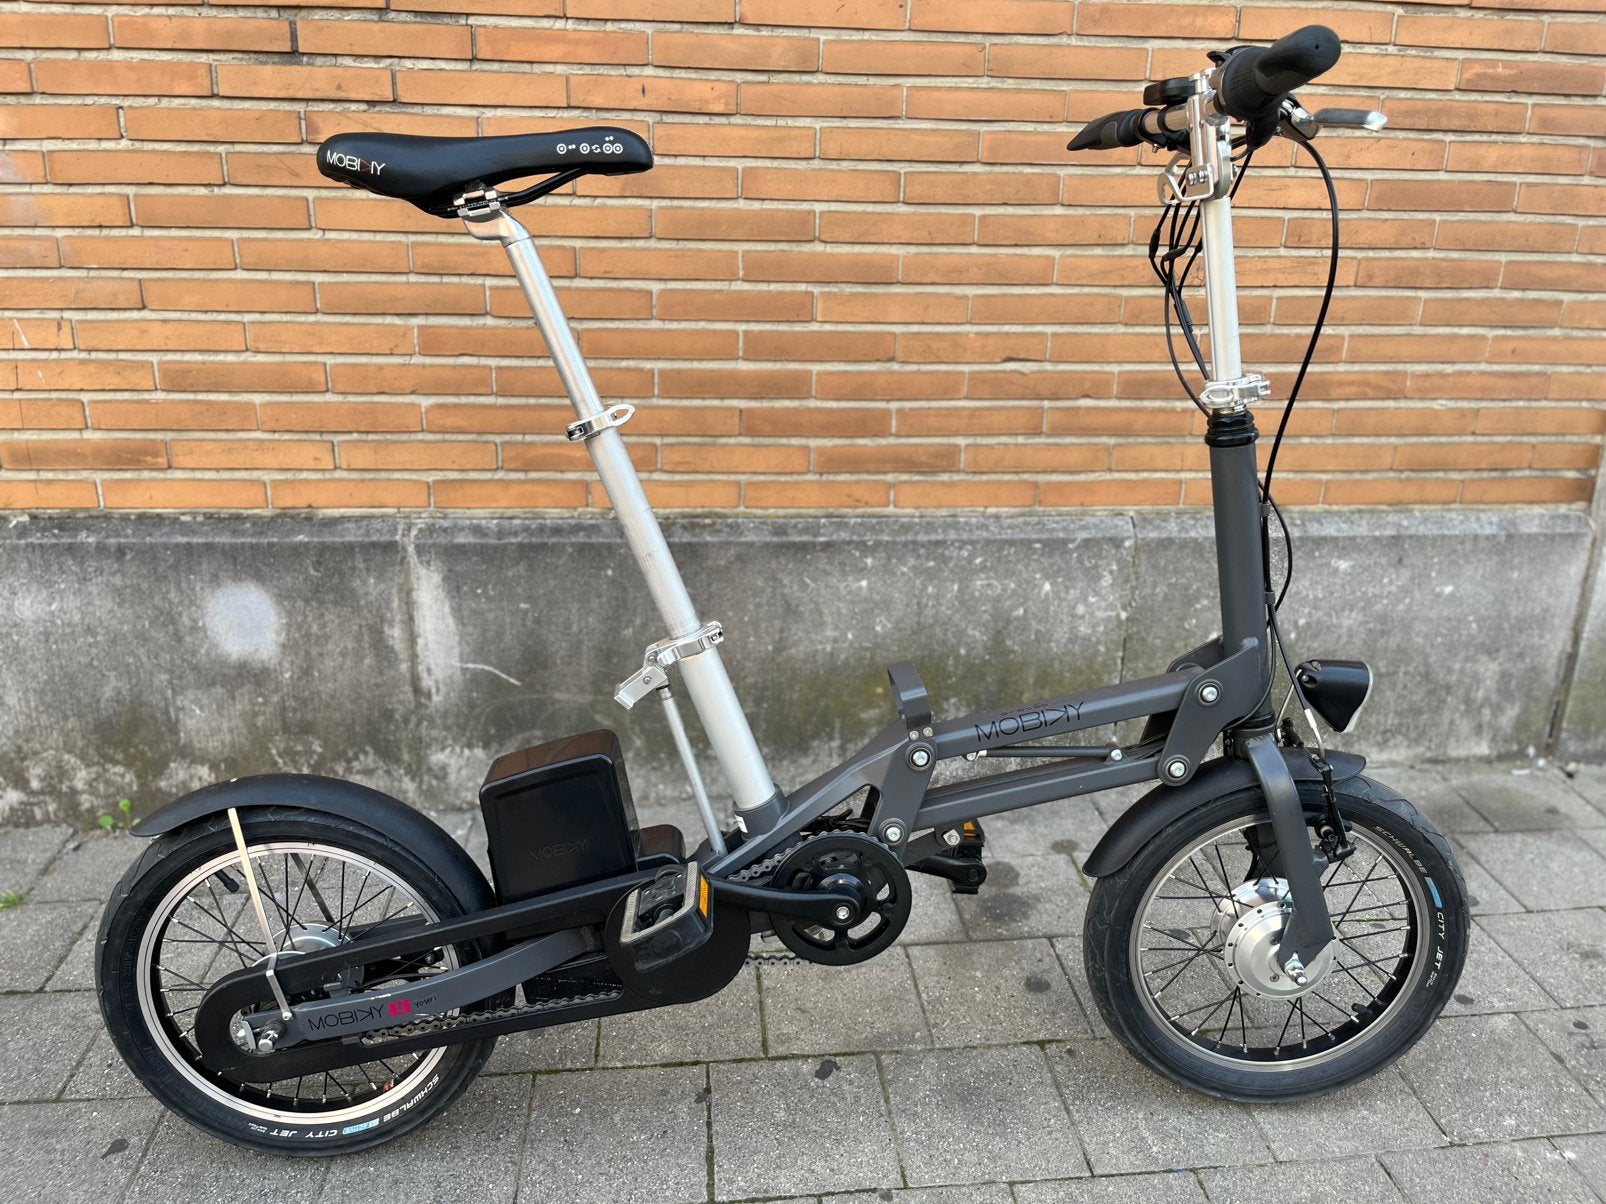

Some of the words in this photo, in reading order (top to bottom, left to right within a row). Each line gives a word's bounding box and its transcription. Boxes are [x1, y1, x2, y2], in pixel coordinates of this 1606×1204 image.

[1374, 825, 1428, 875] SCHWALBE
[1437, 911, 1445, 940] CITY
[1434, 945, 1444, 970] JET
[383, 1073, 440, 1123] SCHWALBE
[270, 1128, 298, 1138] JET
[305, 1129, 338, 1138] CITY
